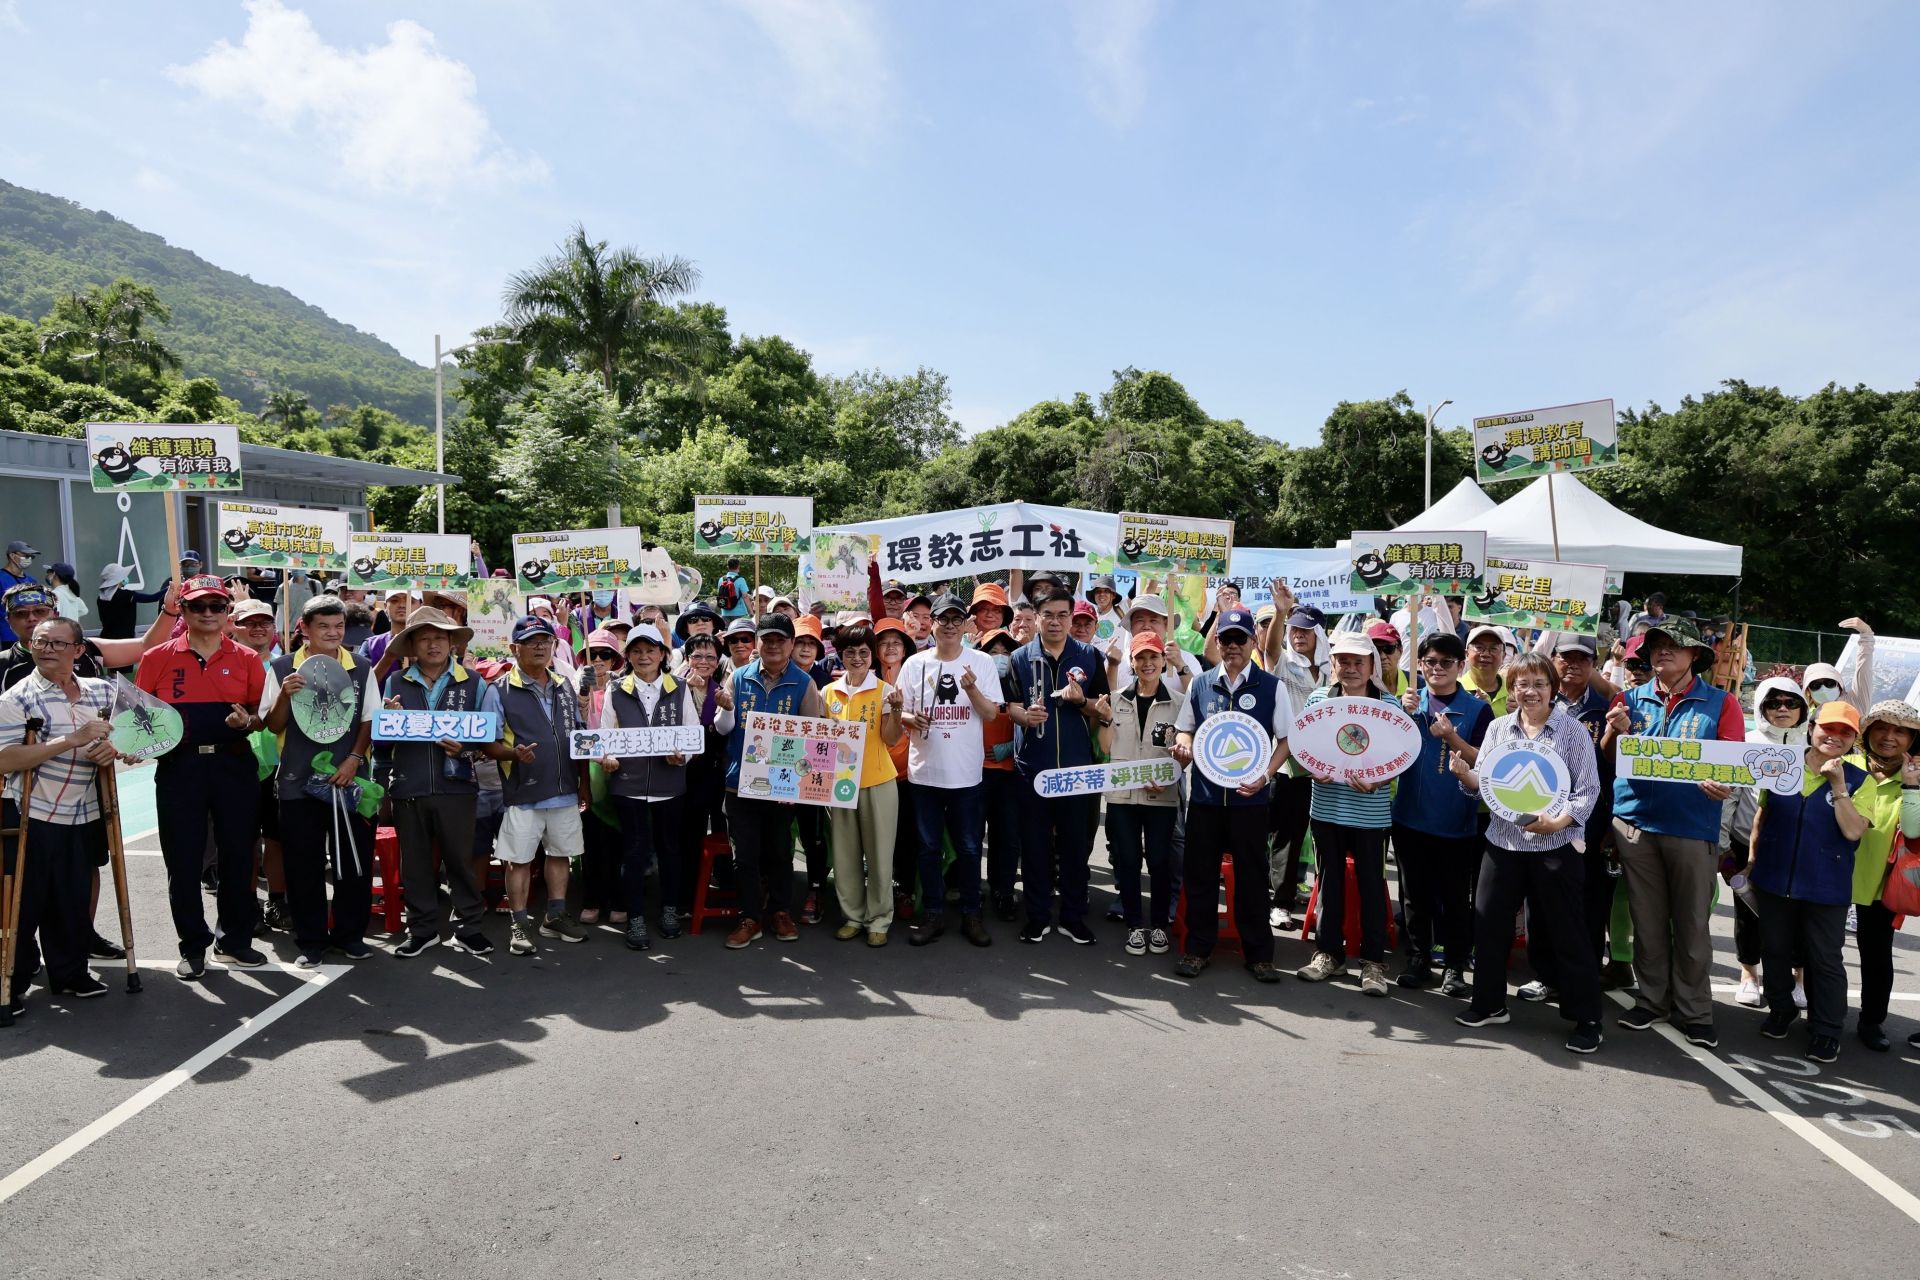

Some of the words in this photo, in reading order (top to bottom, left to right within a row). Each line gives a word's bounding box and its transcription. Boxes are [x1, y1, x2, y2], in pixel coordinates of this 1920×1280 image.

[1505, 421, 1583, 448] 環境教育
[130, 437, 215, 457] 維護環境
[1533, 437, 1592, 462] 講師團
[160, 457, 230, 473] 有你有我
[720, 511, 786, 527] 龍華國小
[247, 520, 322, 539] 高雄市政府
[732, 527, 797, 543] 水巡守隊
[1123, 527, 1227, 547] 日月光半導體製造
[260, 538, 334, 555] 環境保護局
[376, 546, 426, 562] 峰南里
[549, 545, 608, 562] 龍井幸福
[886, 524, 1086, 572] 環教志工社
[1147, 545, 1225, 561] 股份有限公司
[1384, 543, 1461, 562] 維護環境
[386, 563, 457, 576] 環保志工隊
[556, 560, 629, 576] 環保志工隊
[1409, 564, 1473, 578] 有你有我
[1293, 578, 1325, 588] Zone
[1496, 574, 1552, 595] 厚生里
[1322, 600, 1357, 609] 只有更好
[1505, 594, 1586, 616] 環保志工隊
[172, 668, 185, 699] FILA
[924, 706, 970, 720] KOHSIUNG
[379, 712, 487, 738] 改變文化
[601, 728, 702, 755] 從我做起
[816, 742, 829, 756] 倒
[1507, 742, 1551, 756] 環境部
[1620, 737, 1701, 760] 從小事情
[1042, 769, 1105, 794] 減菸蒂
[1111, 762, 1176, 788] 淨環境
[1632, 758, 1757, 785] 開始改變環境
[1480, 776, 1501, 812] Ministry
[1503, 811, 1513, 819] of
